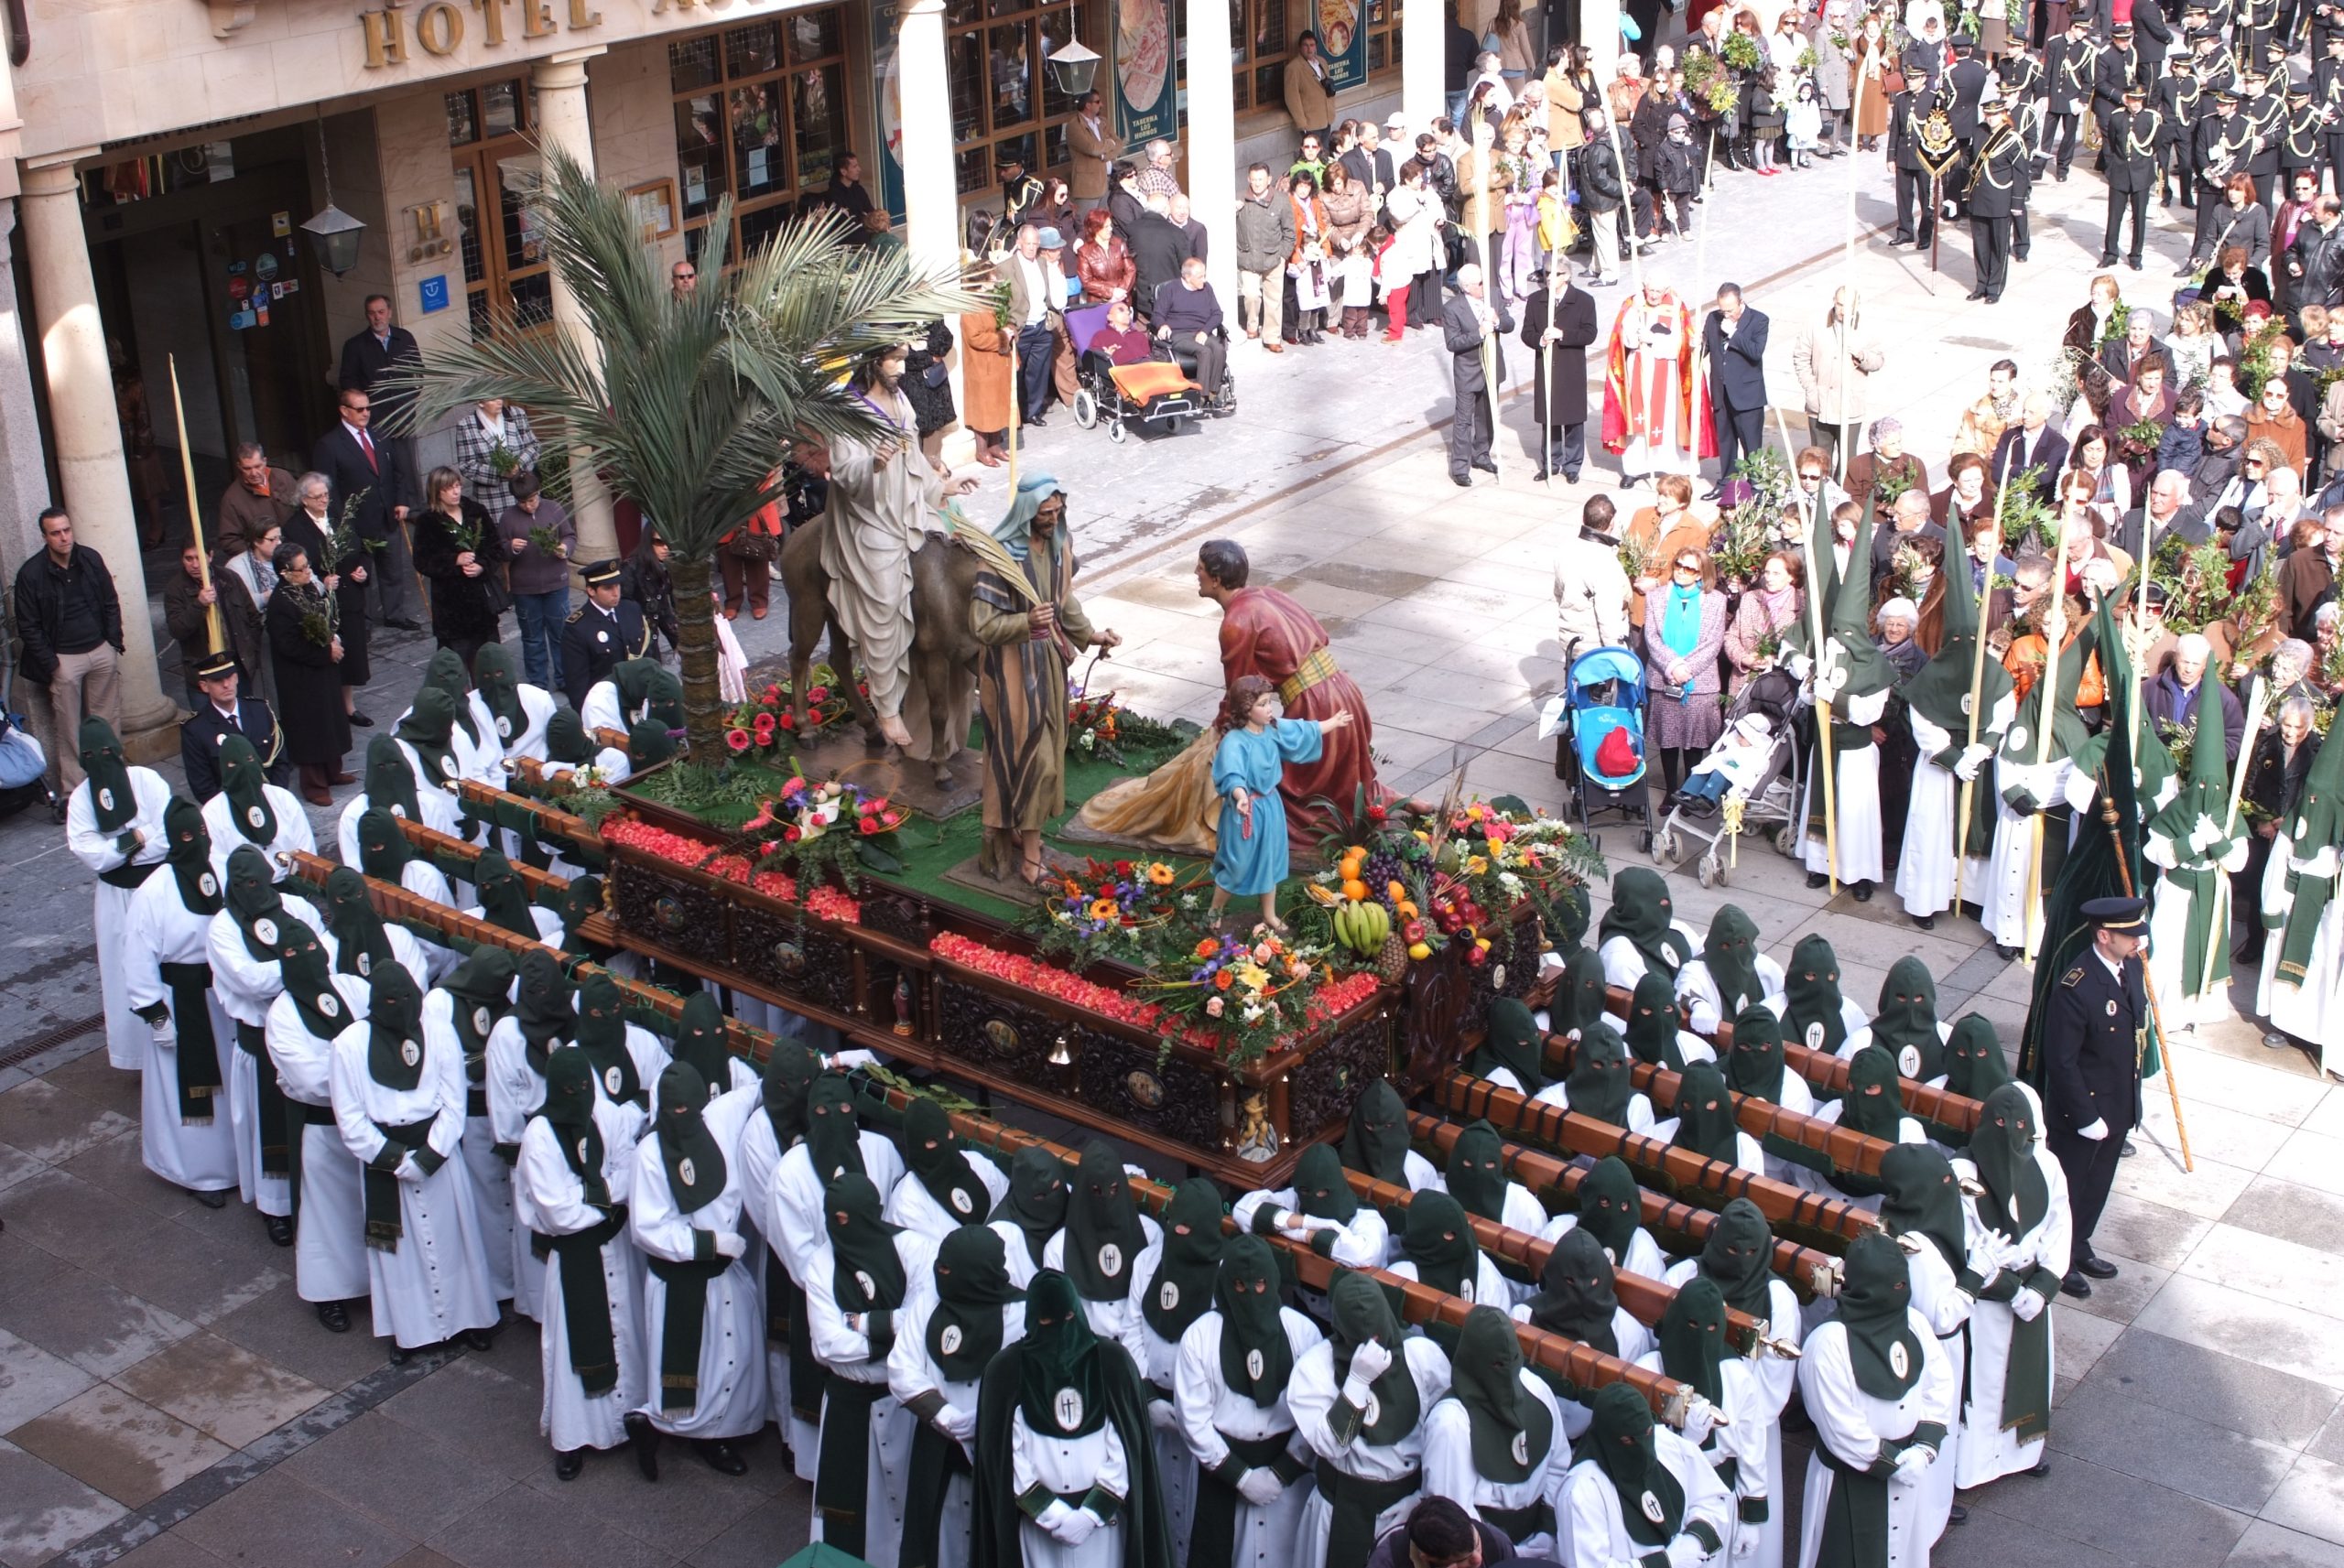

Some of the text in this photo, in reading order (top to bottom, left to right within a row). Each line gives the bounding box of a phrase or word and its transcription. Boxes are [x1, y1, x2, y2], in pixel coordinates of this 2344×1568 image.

[361, 0, 602, 68] HOTEL
[1132, 114, 1158, 127] TABERNA
[1134, 127, 1158, 140] HORNOS
[1140, 123, 1151, 132] LOS
